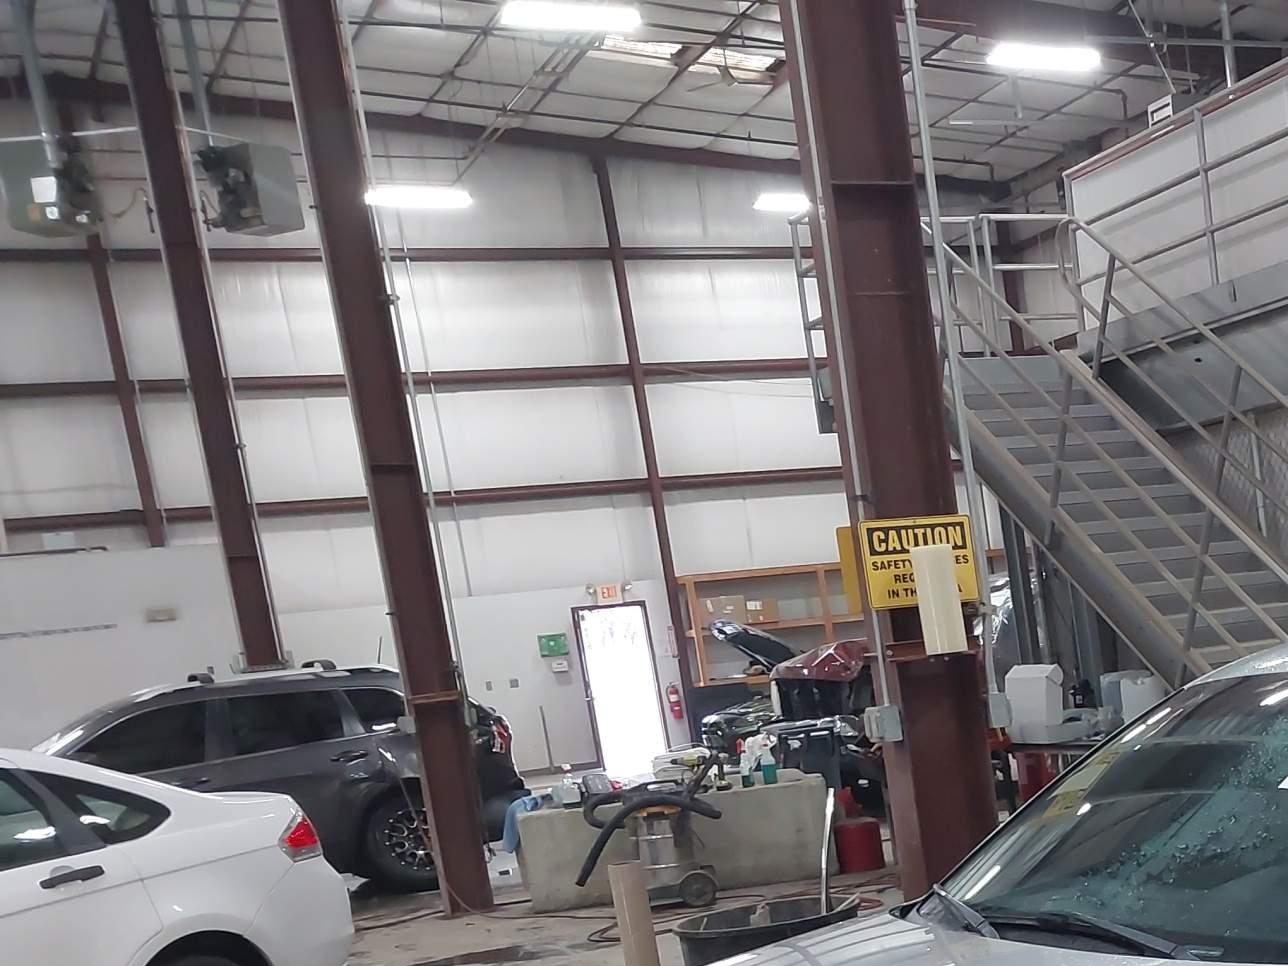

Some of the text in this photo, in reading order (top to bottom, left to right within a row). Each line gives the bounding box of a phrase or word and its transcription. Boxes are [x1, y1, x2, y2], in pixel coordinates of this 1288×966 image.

[872, 526, 963, 552] CAUTION
[888, 587, 917, 599] IN TH
